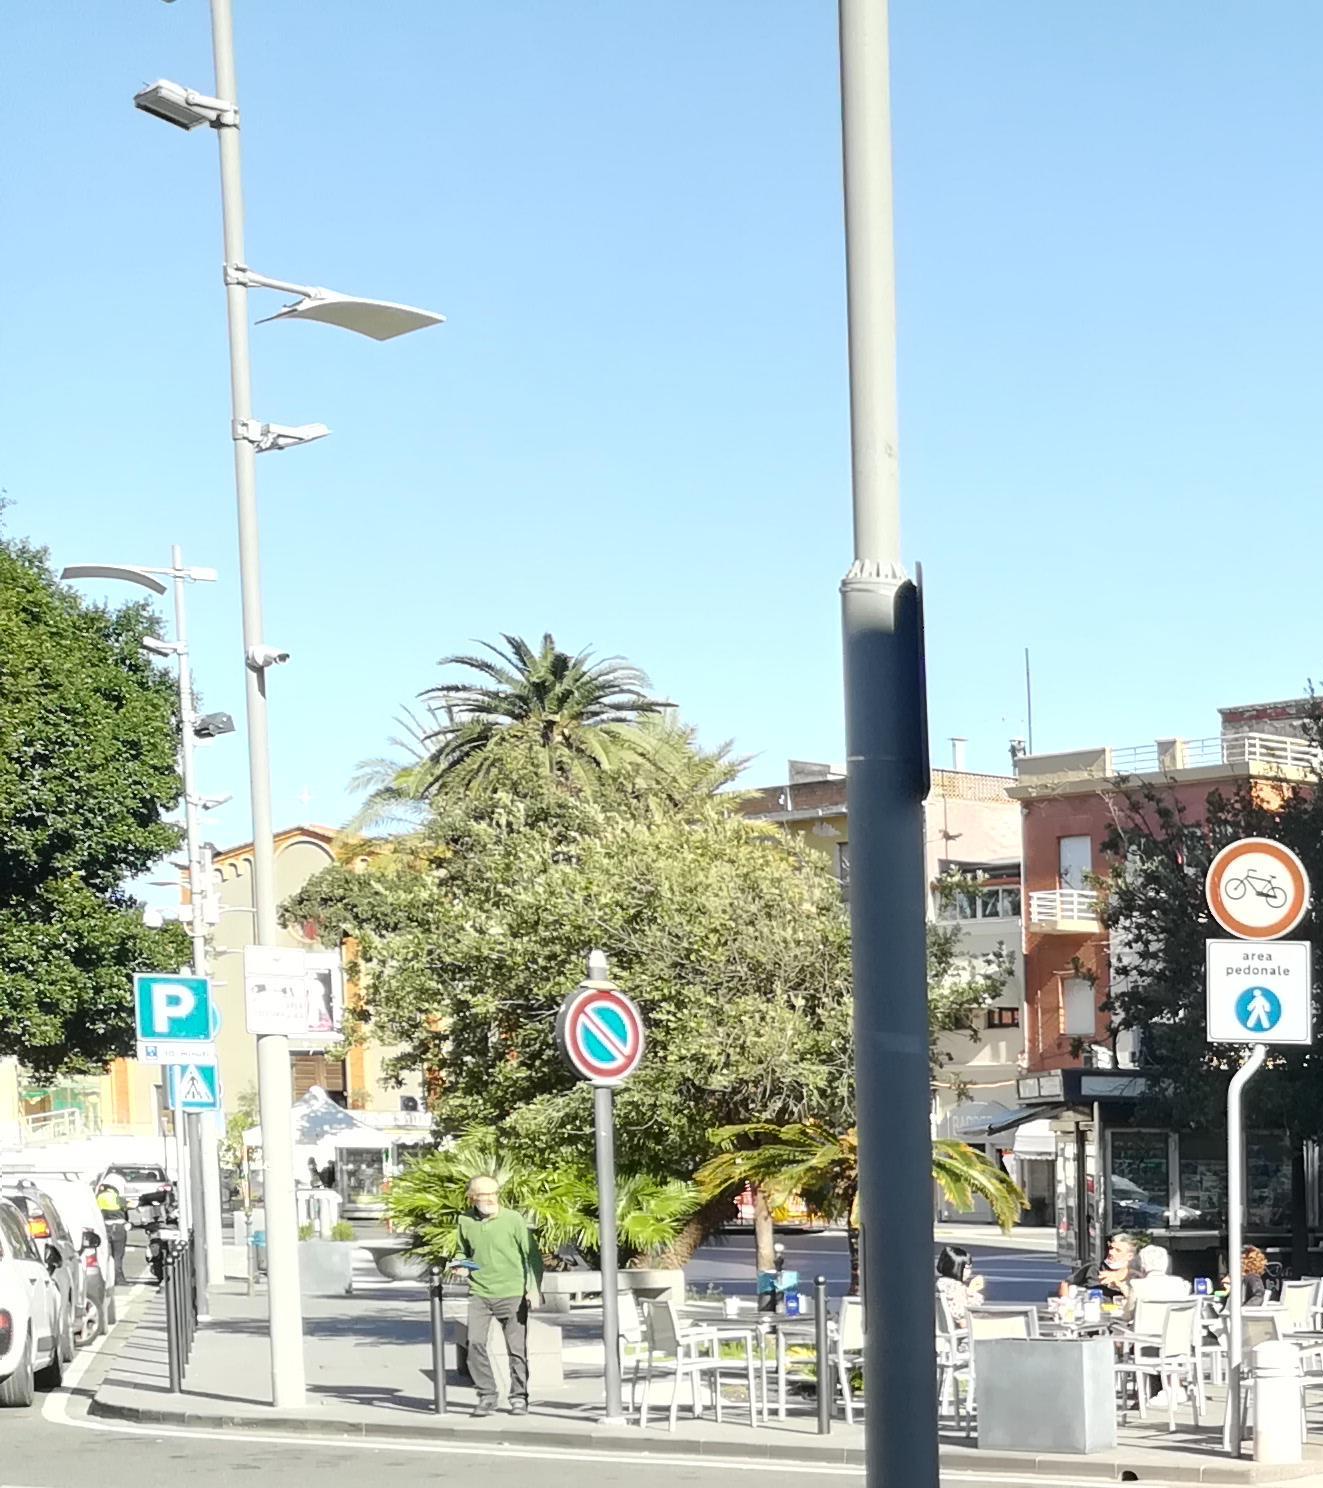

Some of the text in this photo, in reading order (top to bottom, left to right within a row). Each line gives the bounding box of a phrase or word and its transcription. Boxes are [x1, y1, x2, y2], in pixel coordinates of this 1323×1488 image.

[1242, 952, 1272, 961] area
[1226, 965, 1290, 976] pedonale
[151, 983, 196, 1034] P
